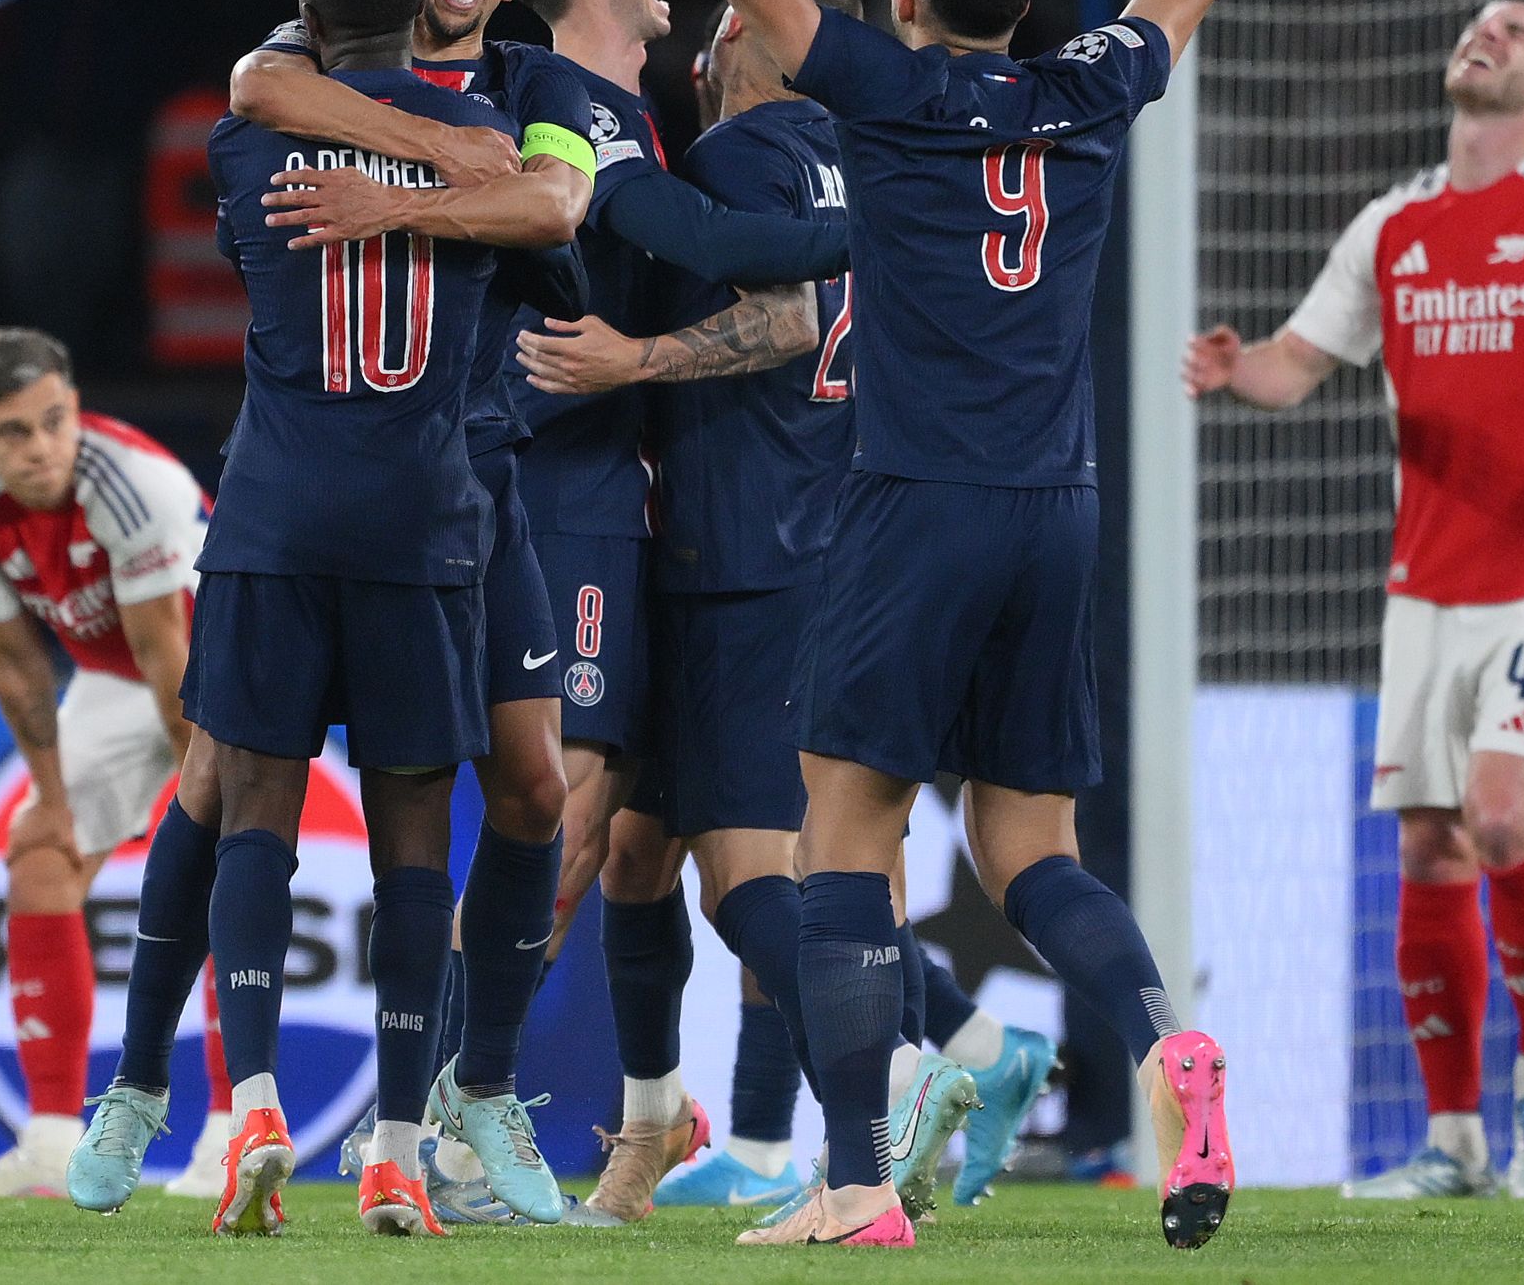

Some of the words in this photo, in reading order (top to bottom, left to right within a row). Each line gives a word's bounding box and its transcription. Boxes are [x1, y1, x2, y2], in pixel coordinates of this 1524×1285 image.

[981, 138, 1055, 292] 9
[308, 223, 435, 394] 10
[575, 585, 604, 658] 8
[571, 664, 598, 677] PARIS
[861, 945, 901, 968] PARIS
[230, 969, 270, 990] PARIS
[381, 1010, 424, 1032] PARIS
